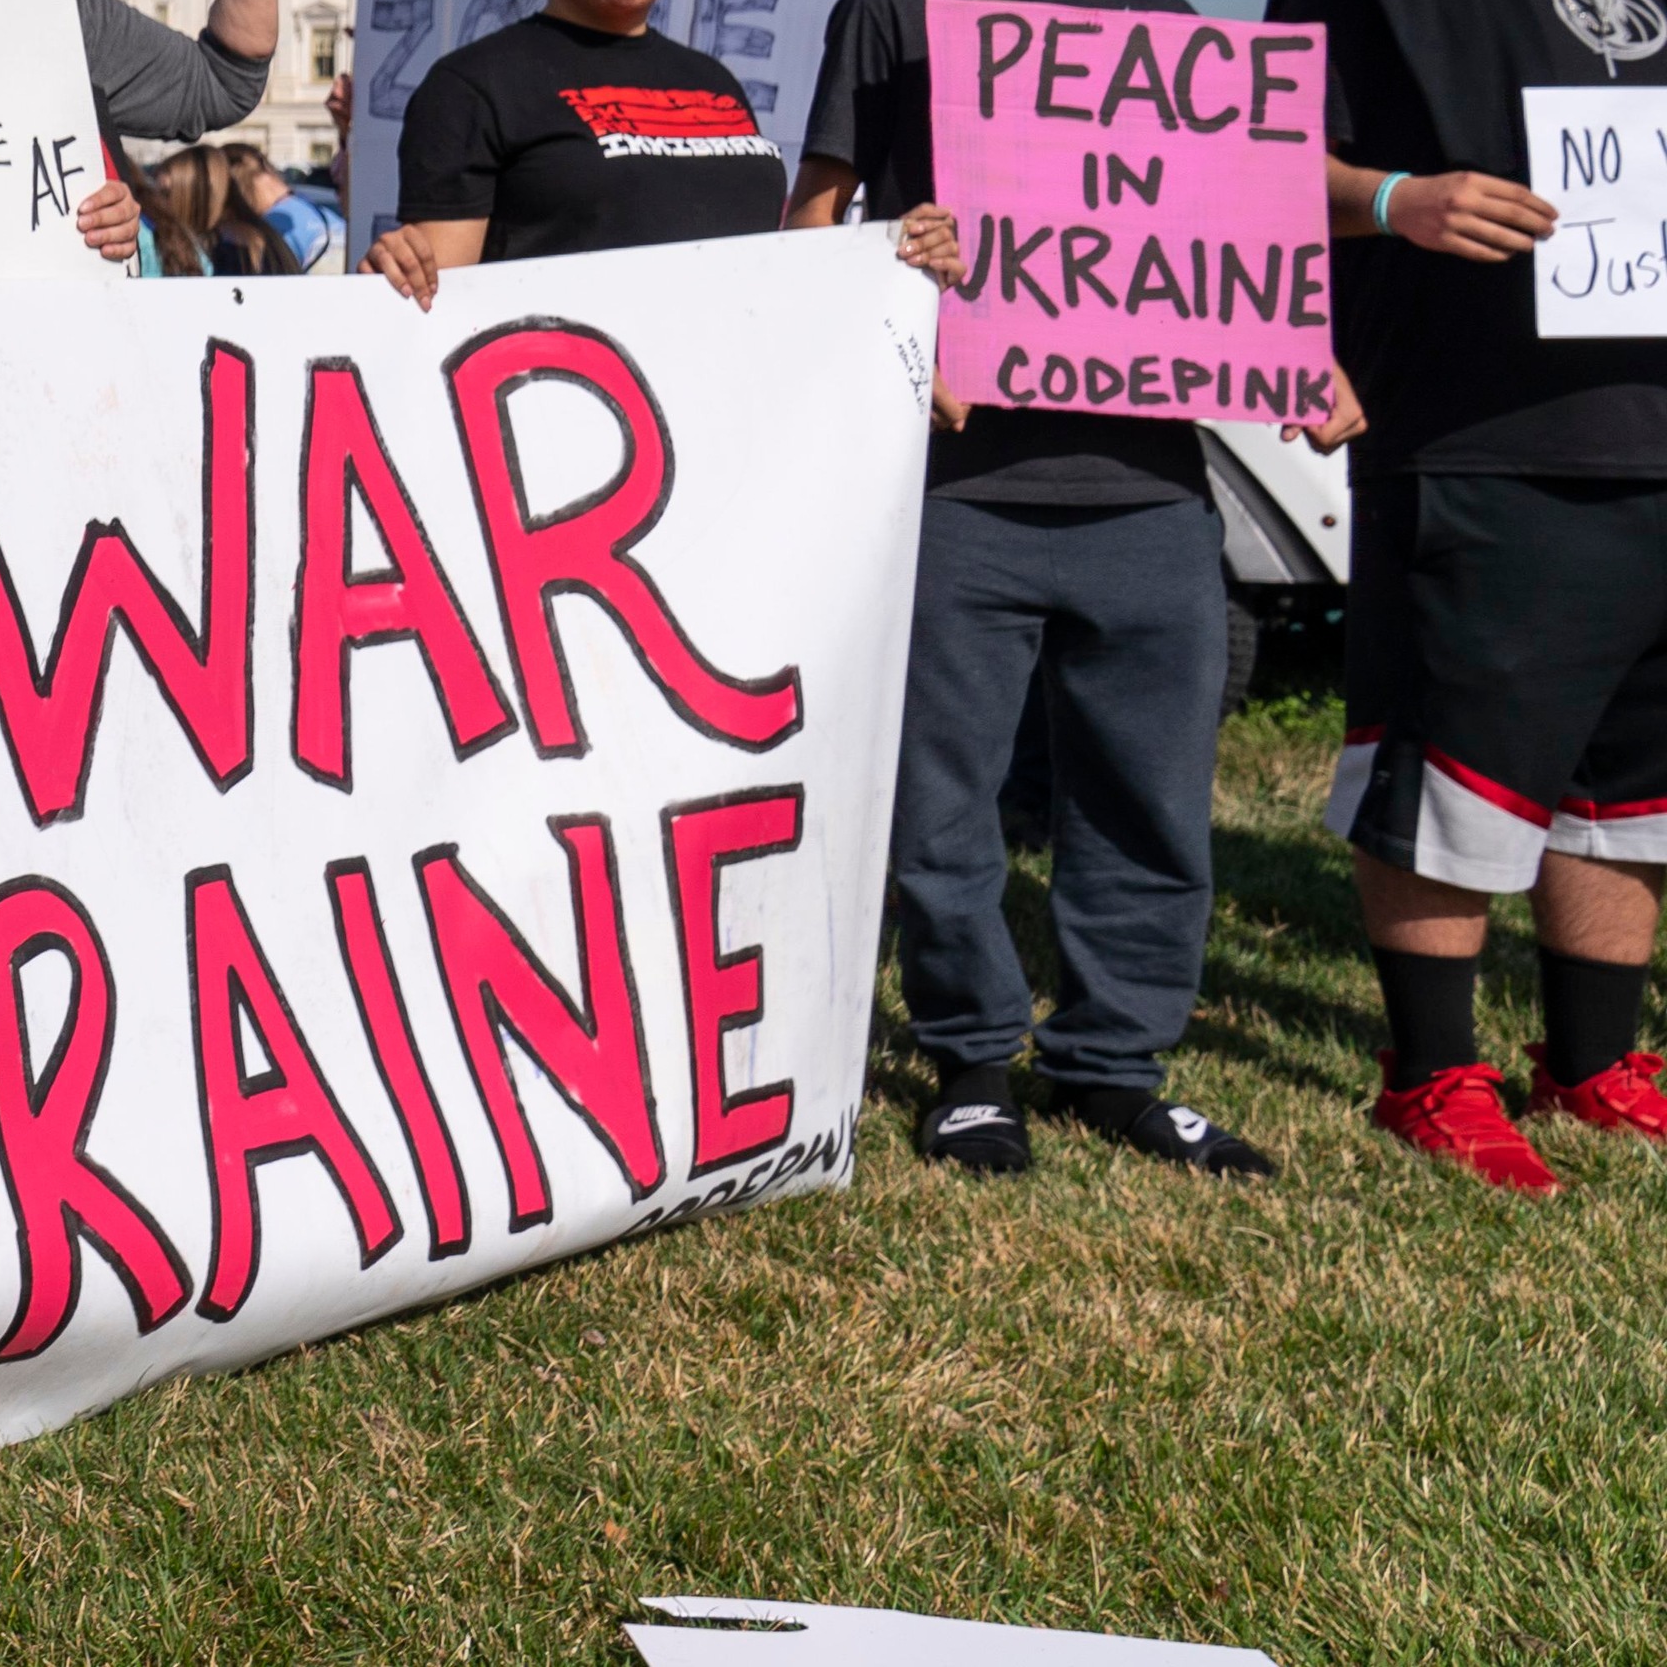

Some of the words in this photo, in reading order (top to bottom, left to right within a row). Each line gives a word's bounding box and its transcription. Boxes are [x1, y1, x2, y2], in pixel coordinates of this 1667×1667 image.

[977, 13, 1315, 143] PEACE
[31, 135, 85, 232] AF
[1083, 152, 1163, 209] IN
[1561, 126, 1621, 191] NO
[997, 345, 1335, 418] CODEPINK
[948, 1104, 1002, 1123] NIKE
